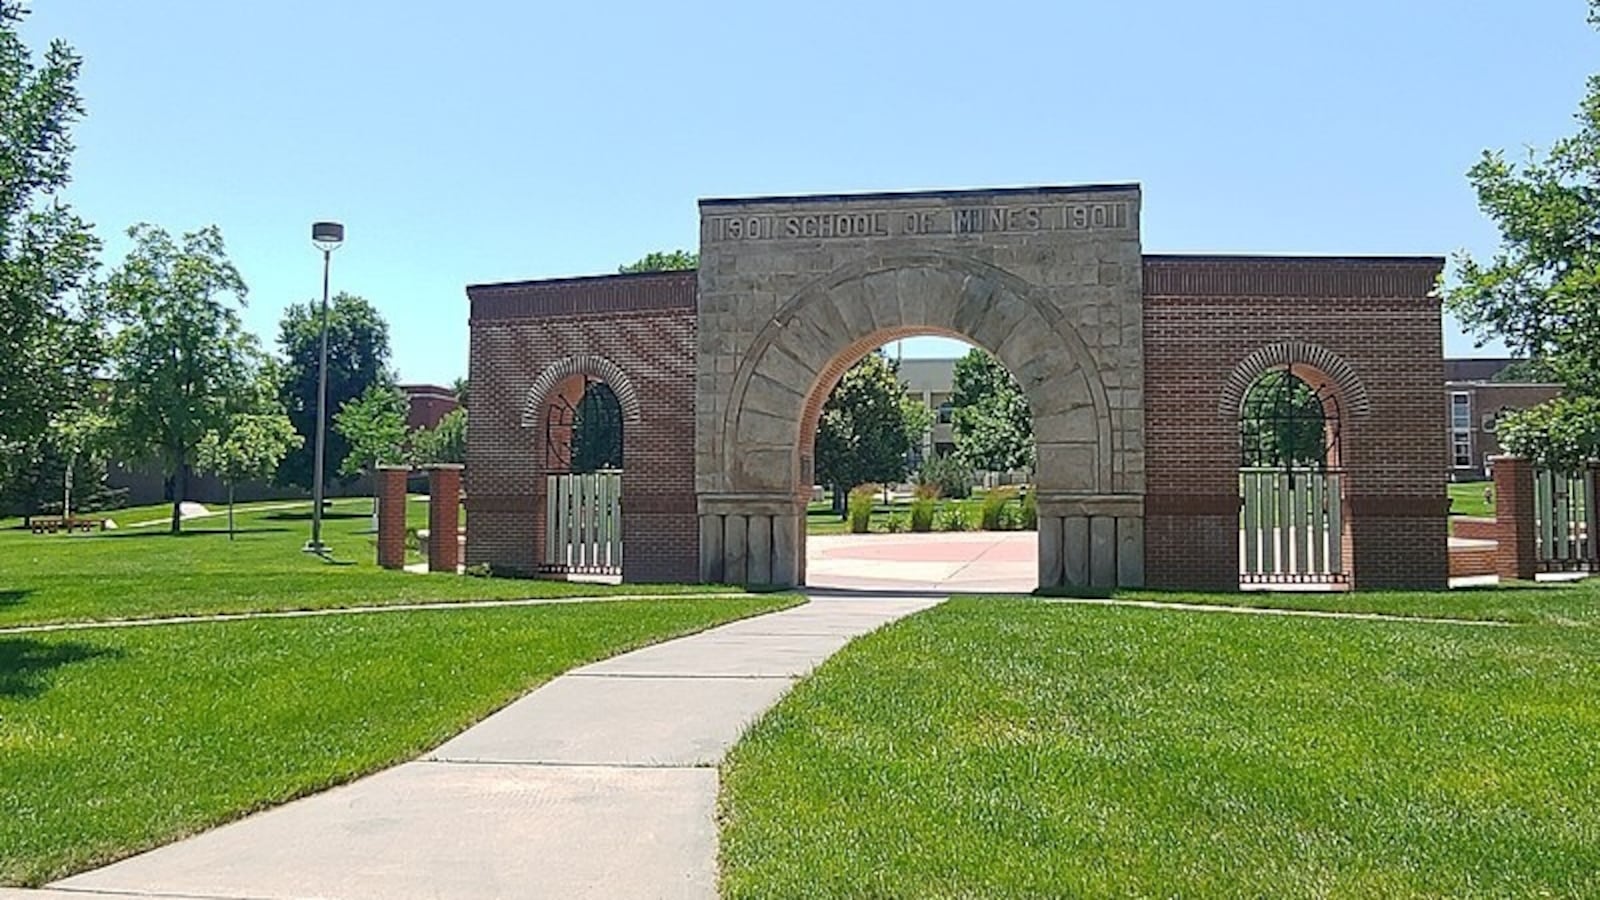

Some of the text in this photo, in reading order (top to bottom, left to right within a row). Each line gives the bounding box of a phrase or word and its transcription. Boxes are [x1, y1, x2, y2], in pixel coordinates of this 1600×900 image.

[785, 214, 887, 238] SCHOOL
[903, 212, 934, 234] OF
[956, 207, 1041, 234] MINES
[1063, 204, 1119, 229] 1901
